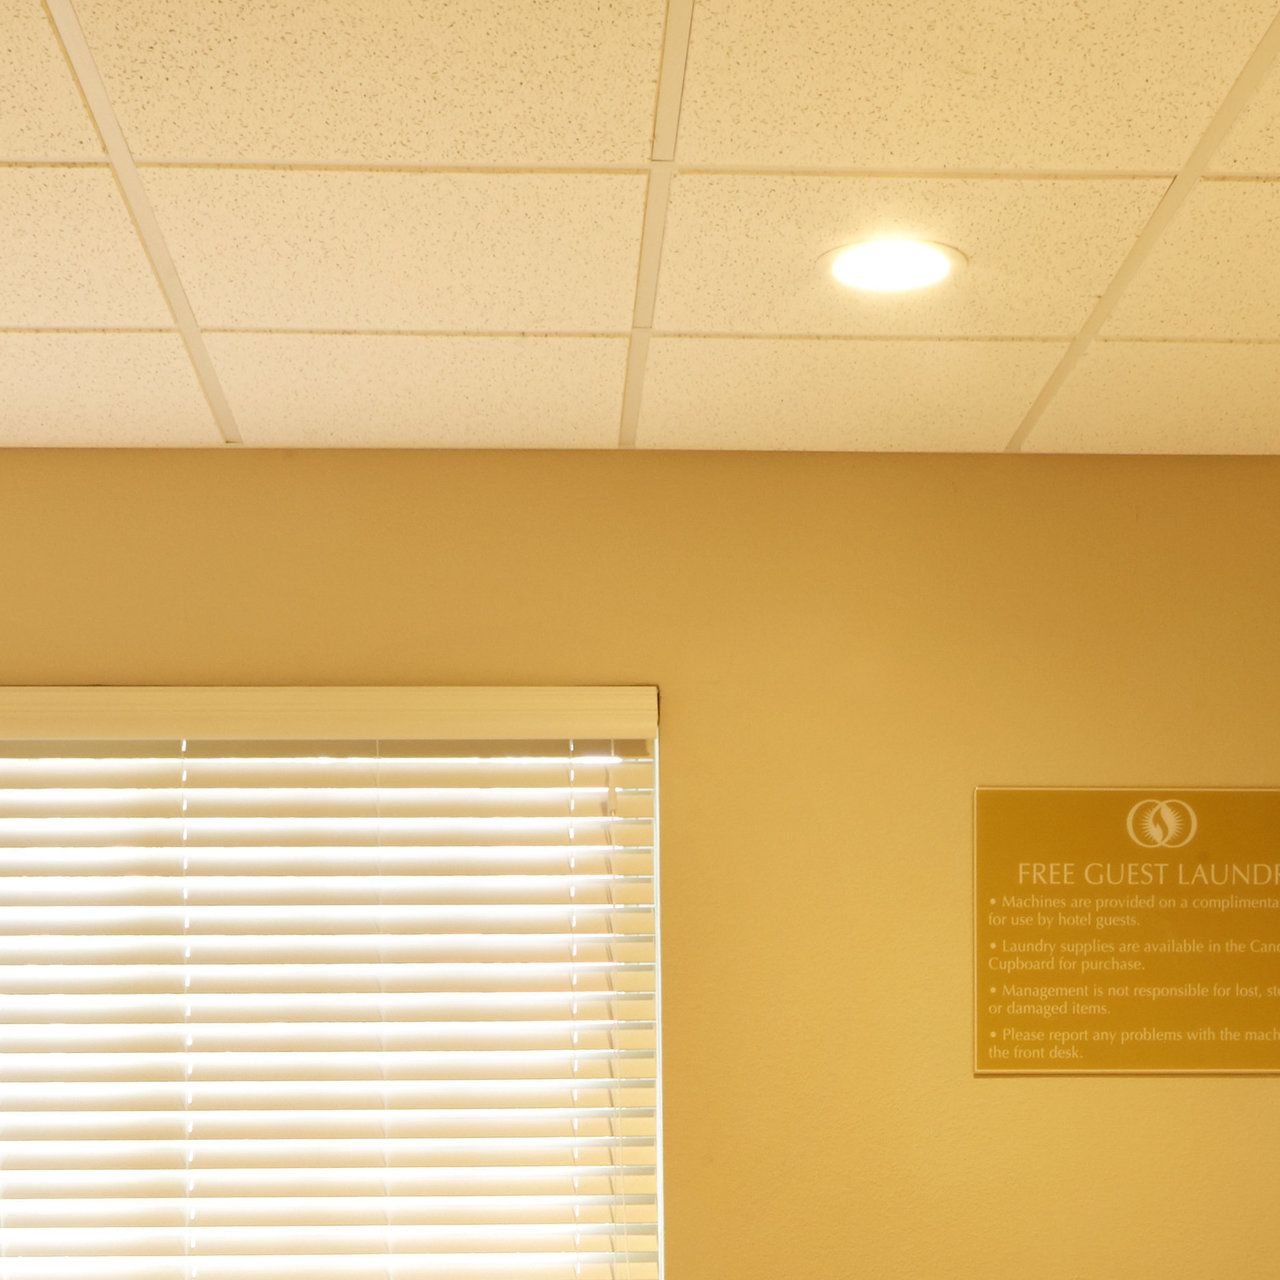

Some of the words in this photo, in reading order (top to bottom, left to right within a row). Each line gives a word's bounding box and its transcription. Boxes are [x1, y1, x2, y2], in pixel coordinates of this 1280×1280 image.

[1018, 863, 1075, 885] FREE
[1084, 863, 1169, 885] GUEST
[1002, 895, 1066, 909] Machines
[1070, 899, 1092, 908] are
[1095, 895, 1155, 912] provided
[1158, 899, 1177, 909] on
[1180, 899, 1189, 909] a
[988, 913, 1008, 926] for
[1010, 916, 1034, 926] use
[1037, 913, 1054, 929] by
[1058, 913, 1092, 926] hotel
[1095, 916, 1140, 930] guests.
[1002, 939, 1057, 956] Laundry
[1060, 940, 1115, 957] supplies
[1118, 943, 1141, 953] are
[1143, 939, 1205, 953] available
[1208, 940, 1222, 953] in
[1225, 940, 1247, 953] the
[988, 957, 1055, 974] Cupboard
[1058, 957, 1077, 970] for
[1081, 957, 1145, 974] purchase.
[1002, 985, 1089, 1001] Management
[1093, 985, 1104, 997] is
[1107, 987, 1129, 997] not
[1133, 984, 1210, 1001] responsible
[1212, 984, 1232, 997] for
[1235, 985, 1262, 998] lost,
[988, 1005, 1003, 1015] or
[1006, 1001, 1068, 1019] damaged
[1072, 1003, 1111, 1015] items.
[1002, 1028, 1045, 1041] Please
[1049, 1030, 1089, 1045] report
[1092, 1032, 1117, 1045] any
[1120, 1028, 1183, 1045] problems
[1186, 1028, 1216, 1041] with
[1219, 1028, 1241, 1041] the
[988, 1045, 1010, 1059] the
[1013, 1046, 1045, 1059] front
[1049, 1045, 1083, 1059] desk.
